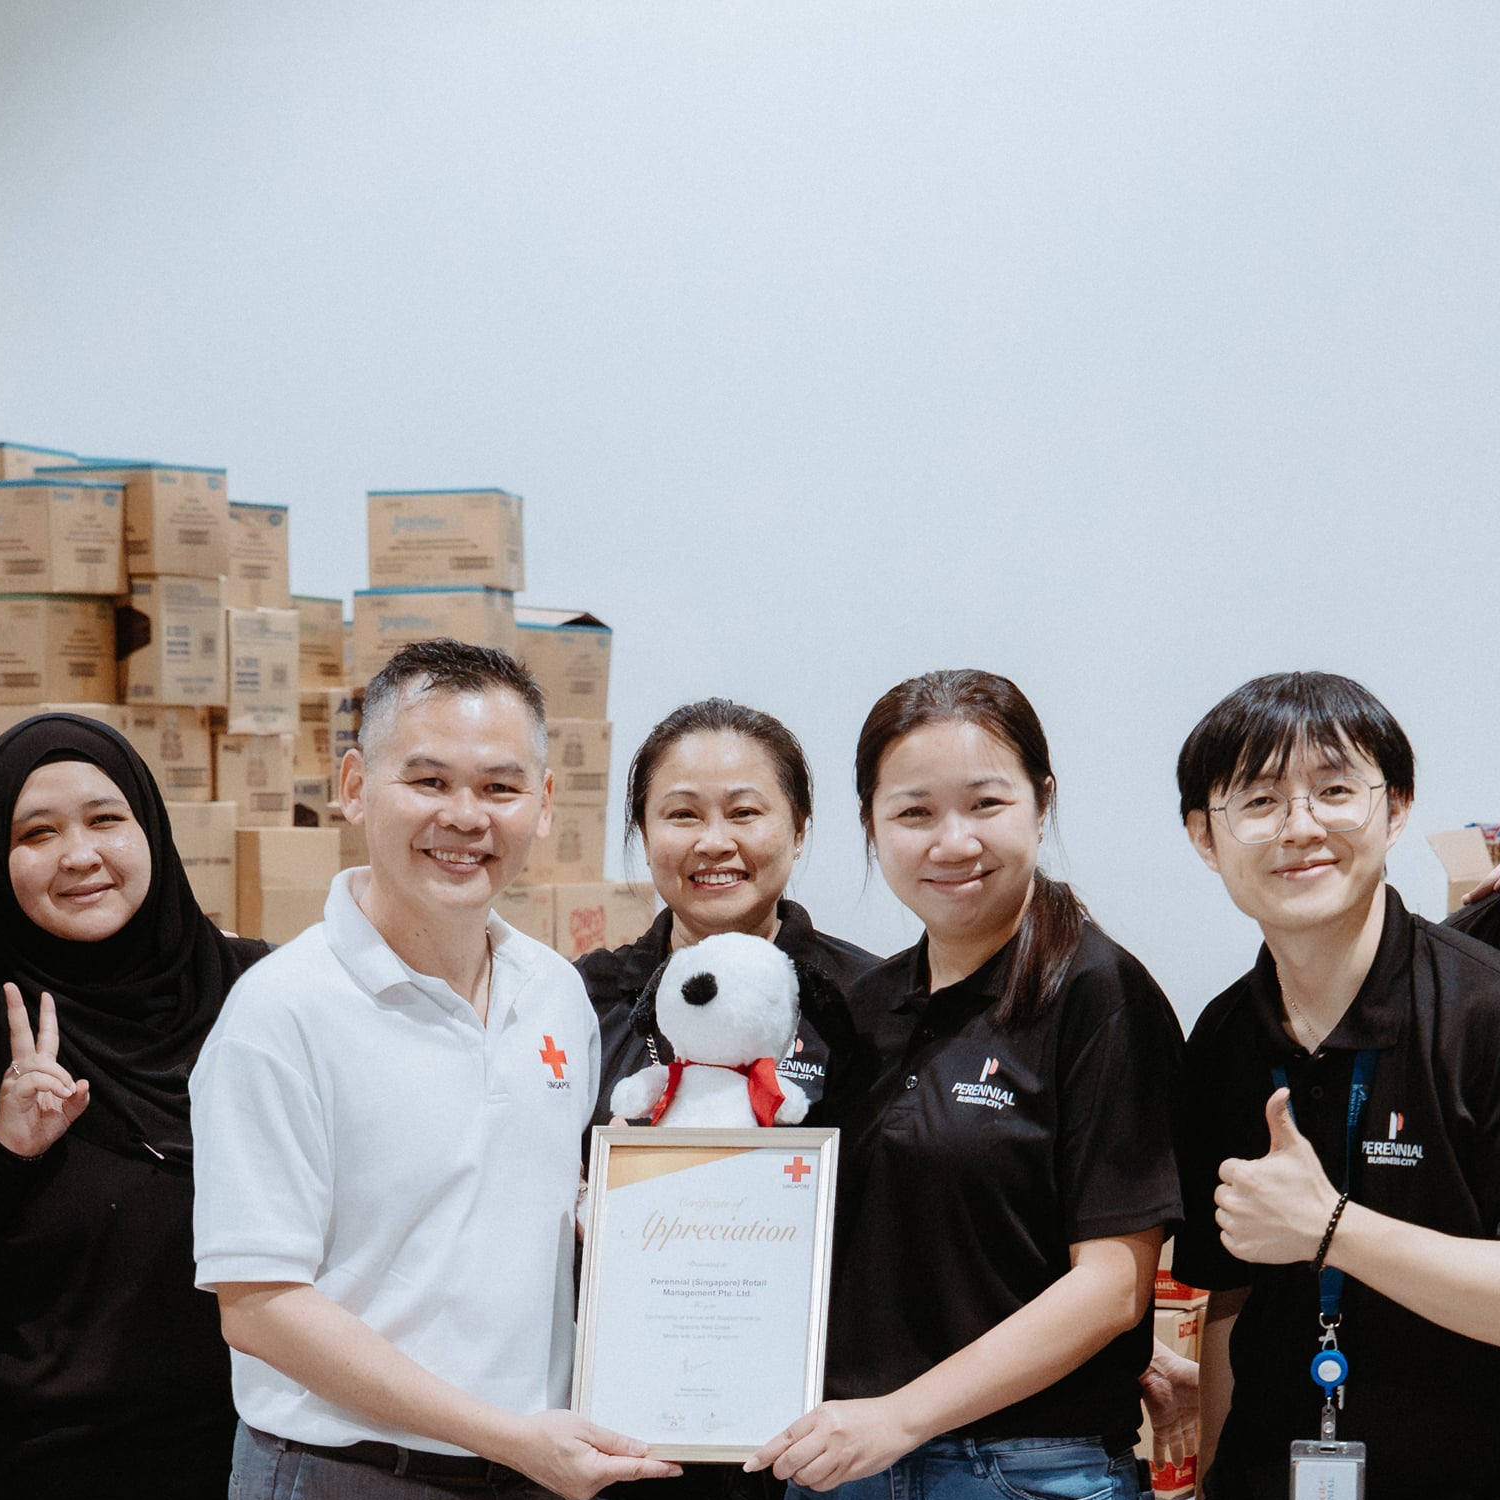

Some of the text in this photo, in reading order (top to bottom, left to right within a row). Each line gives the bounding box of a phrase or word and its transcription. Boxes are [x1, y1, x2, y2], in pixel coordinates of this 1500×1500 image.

[951, 1082, 1016, 1106] PERENNIAL
[986, 1099, 1005, 1111] CITY
[1361, 1141, 1424, 1159] PERENNIAL
[1400, 1158, 1418, 1167] CITY
[636, 1208, 798, 1252] Appreciation
[650, 1278, 767, 1288] Perennial (Singapore) Retail
[662, 1288, 716, 1298] Management
